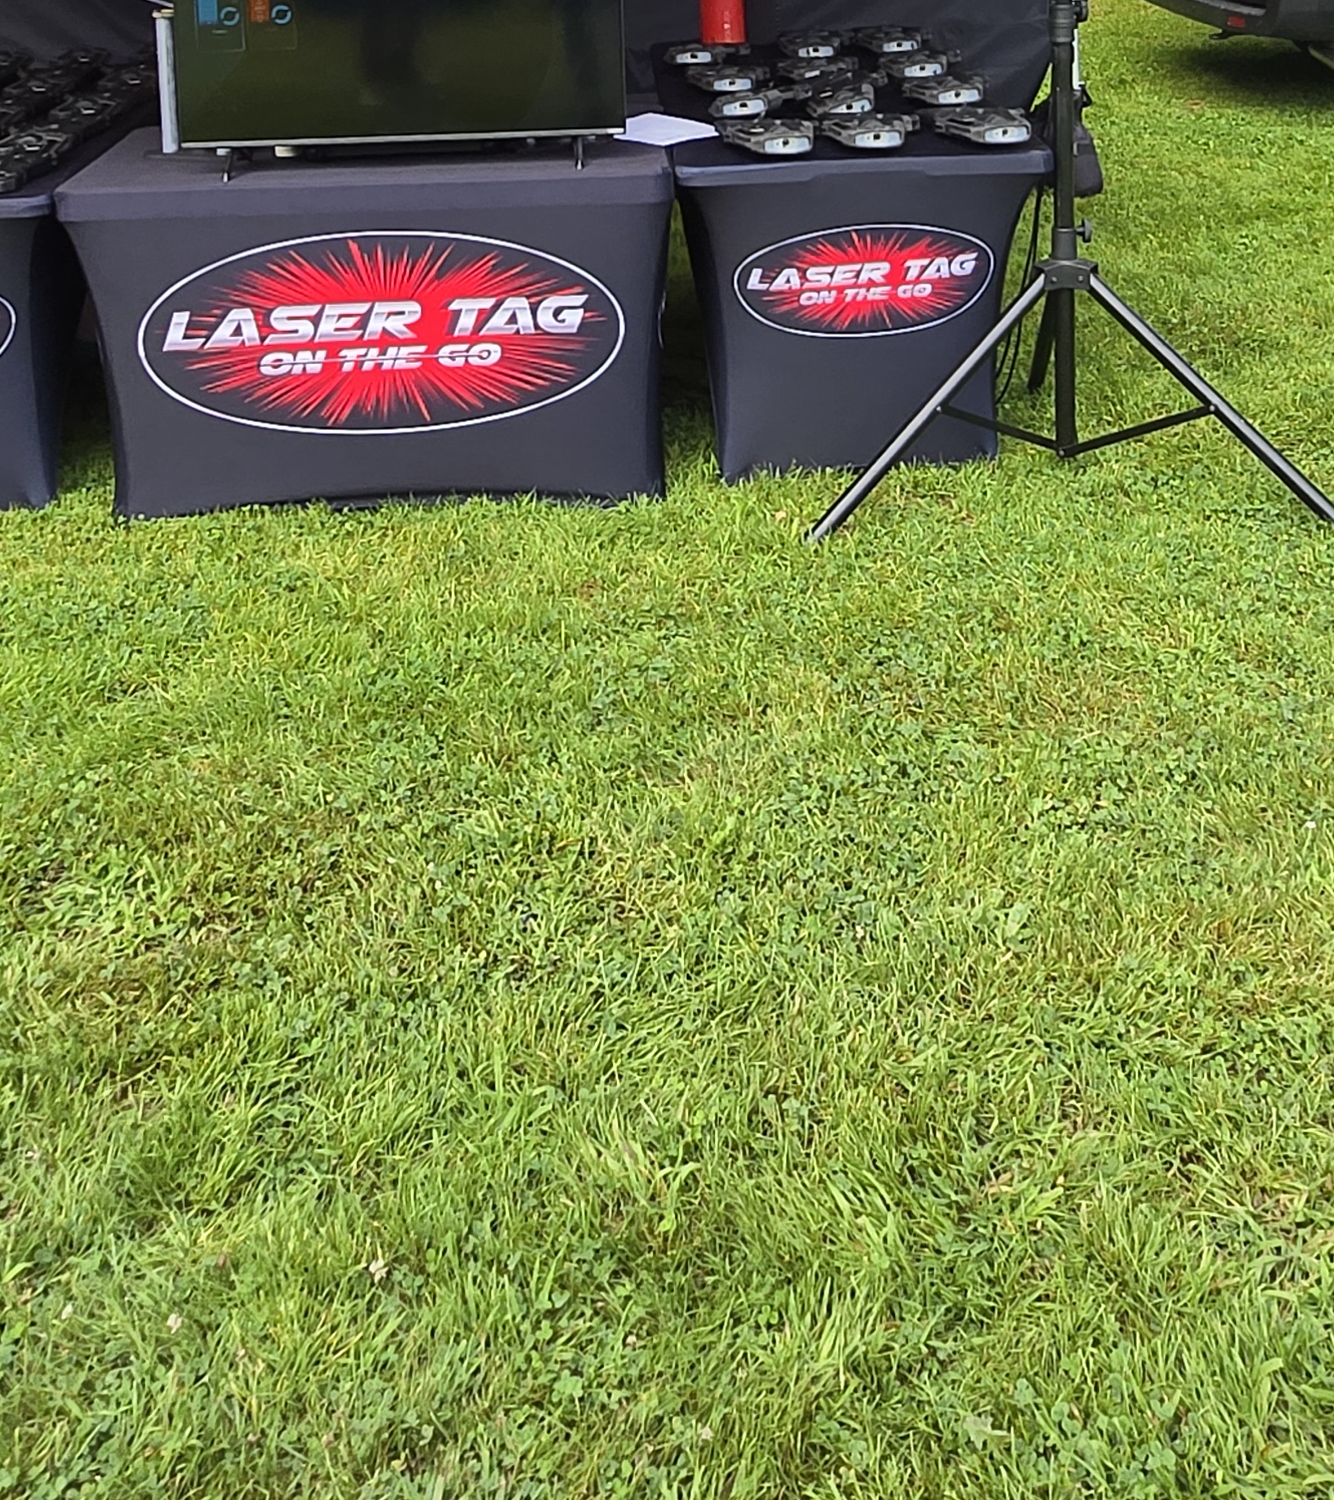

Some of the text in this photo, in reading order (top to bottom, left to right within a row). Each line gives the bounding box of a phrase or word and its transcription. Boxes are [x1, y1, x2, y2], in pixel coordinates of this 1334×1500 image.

[747, 252, 979, 293] LASER TAG
[799, 283, 933, 306] ON THE GO
[162, 294, 589, 352] LASER TAG
[259, 343, 502, 376] ON THE GO
